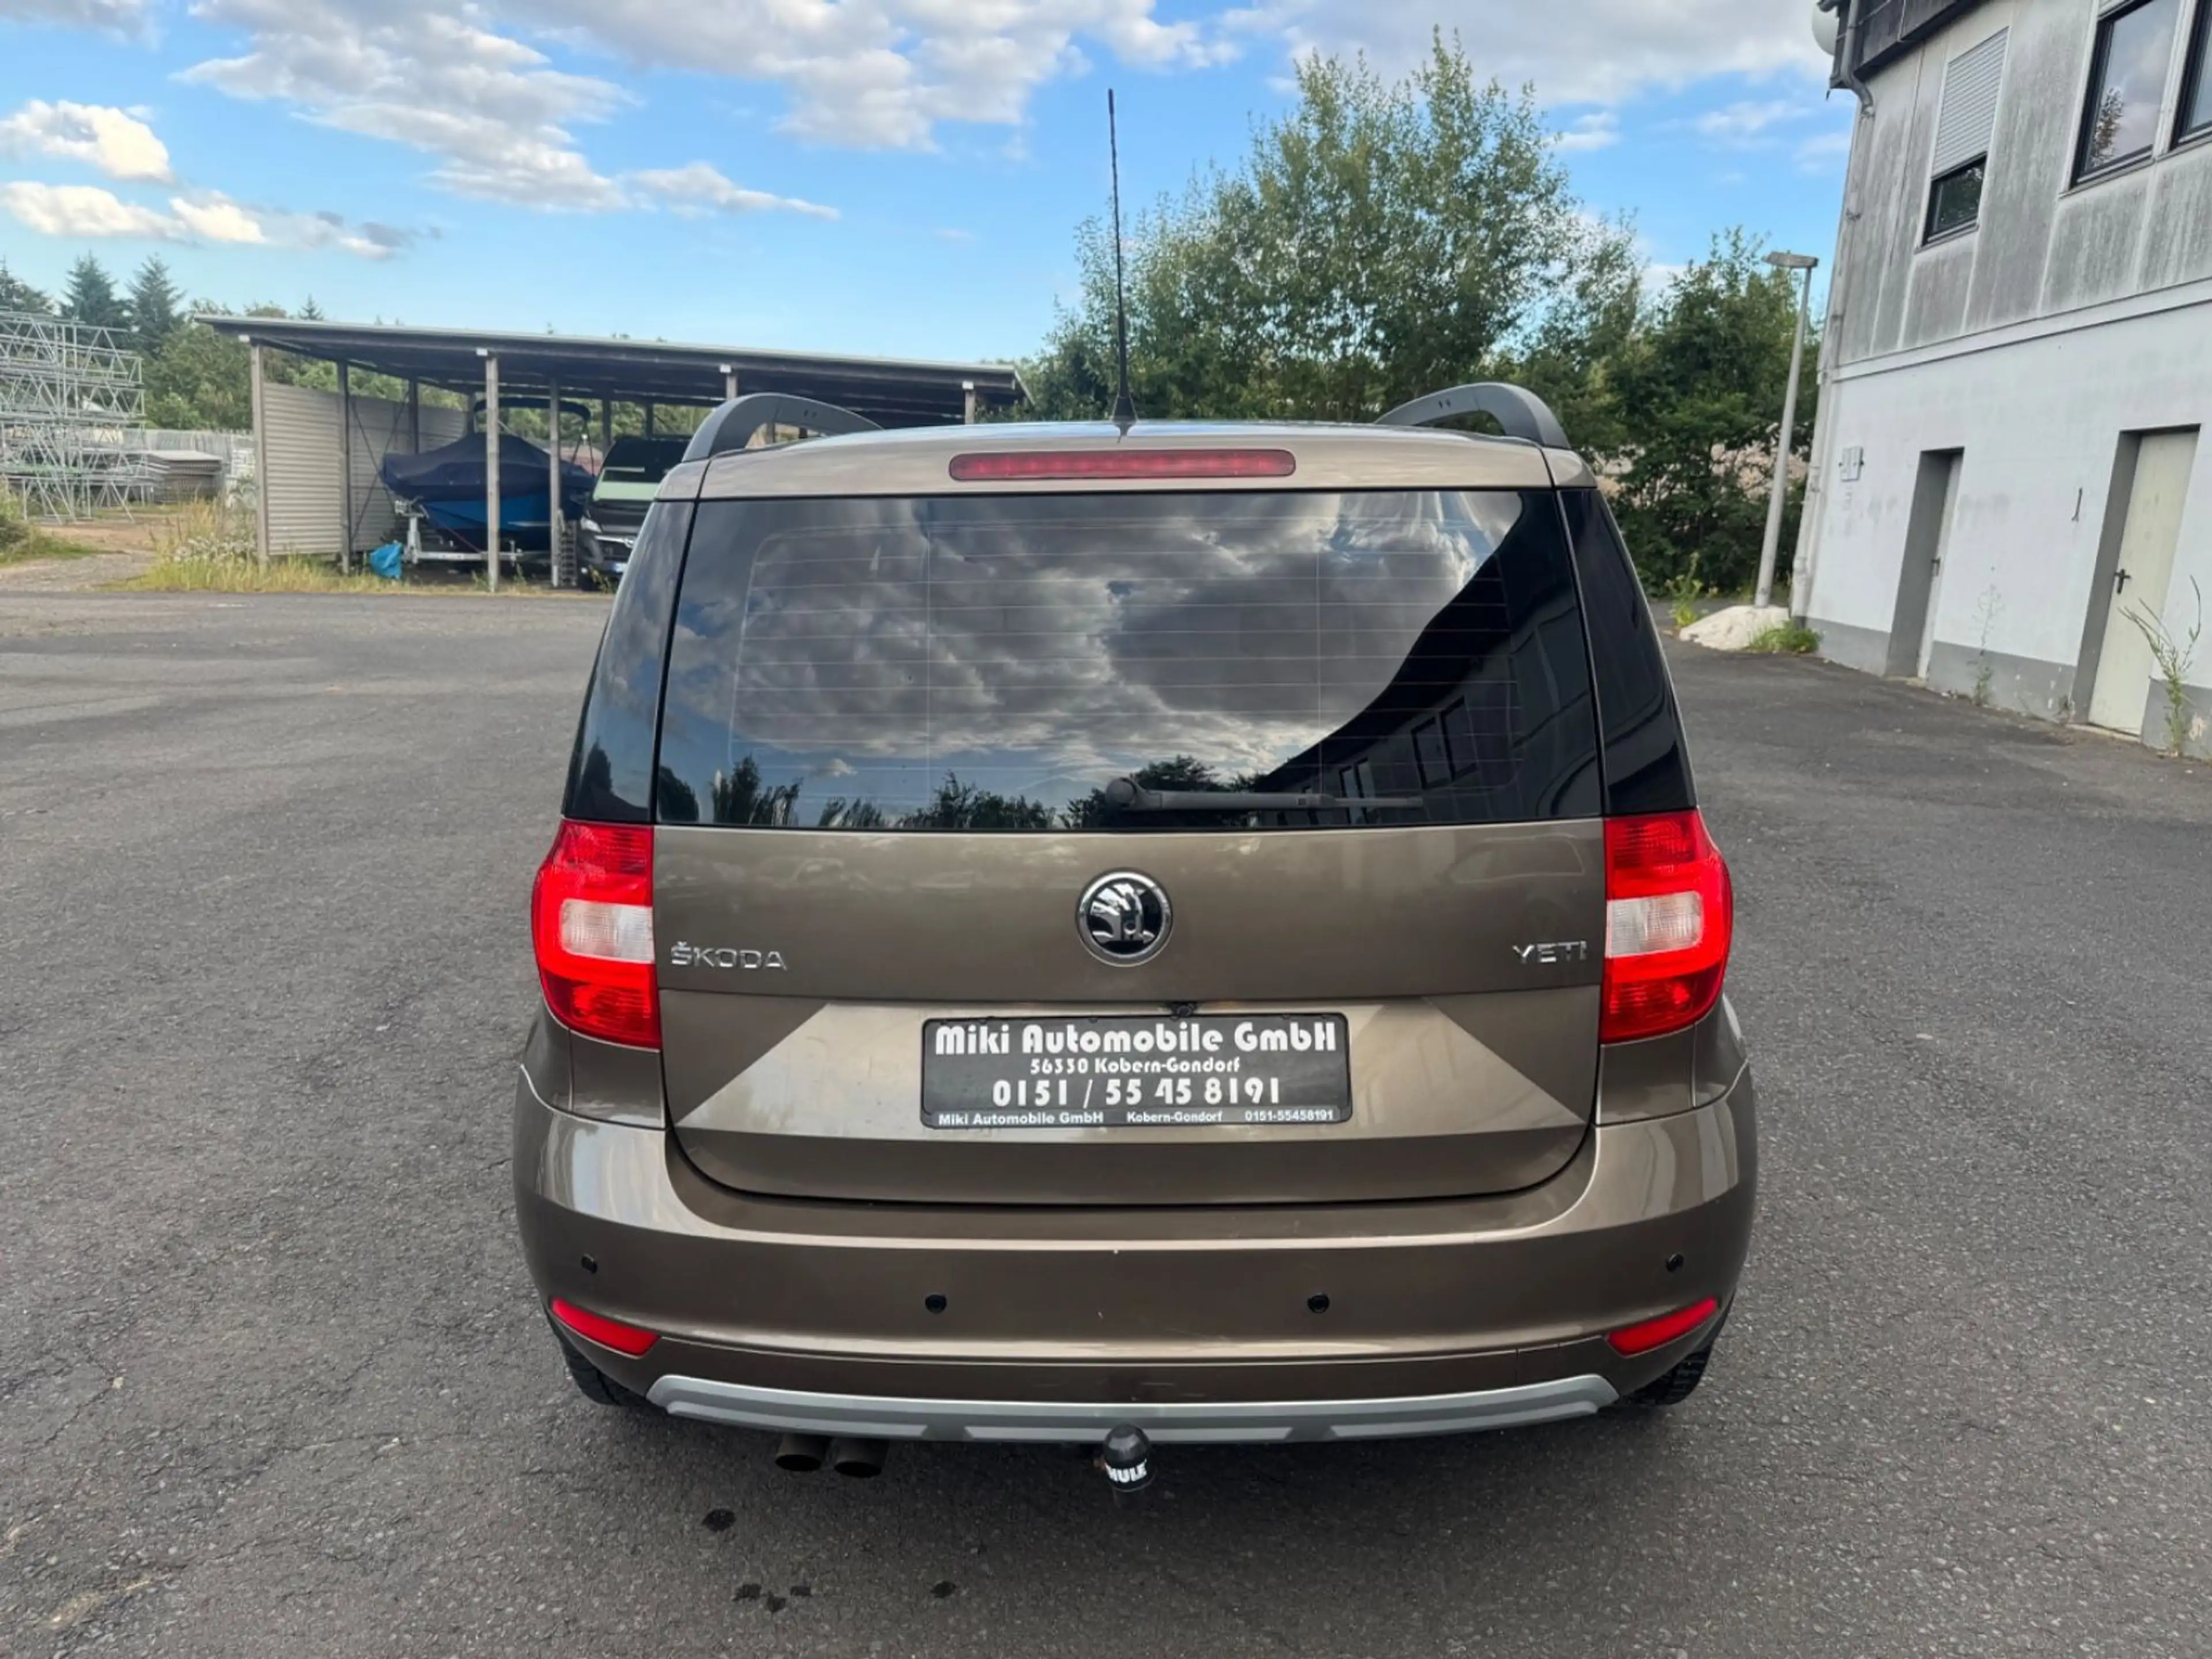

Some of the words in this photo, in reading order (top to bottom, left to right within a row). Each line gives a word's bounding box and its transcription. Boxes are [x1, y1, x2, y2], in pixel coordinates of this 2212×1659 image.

[671, 941, 787, 970] ŠKODA
[1512, 941, 1586, 964] YETI
[935, 1024, 1010, 1055] Miki
[1022, 1022, 1224, 1054] Automobile
[1234, 1022, 1336, 1052] GmbH
[1095, 1056, 1240, 1074] Kobern-Gondorf
[993, 1080, 1067, 1107] 0151
[1083, 1078, 1093, 1109] /
[1105, 1078, 1142, 1105] 55
[1154, 1078, 1191, 1104] 45
[1204, 1077, 1279, 1104] 8191
[938, 1113, 968, 1126] Miki
[972, 1113, 1055, 1124] Automobile
[1059, 1112, 1104, 1124] GmbH
[1127, 1111, 1223, 1123] Kobern-Gondorf
